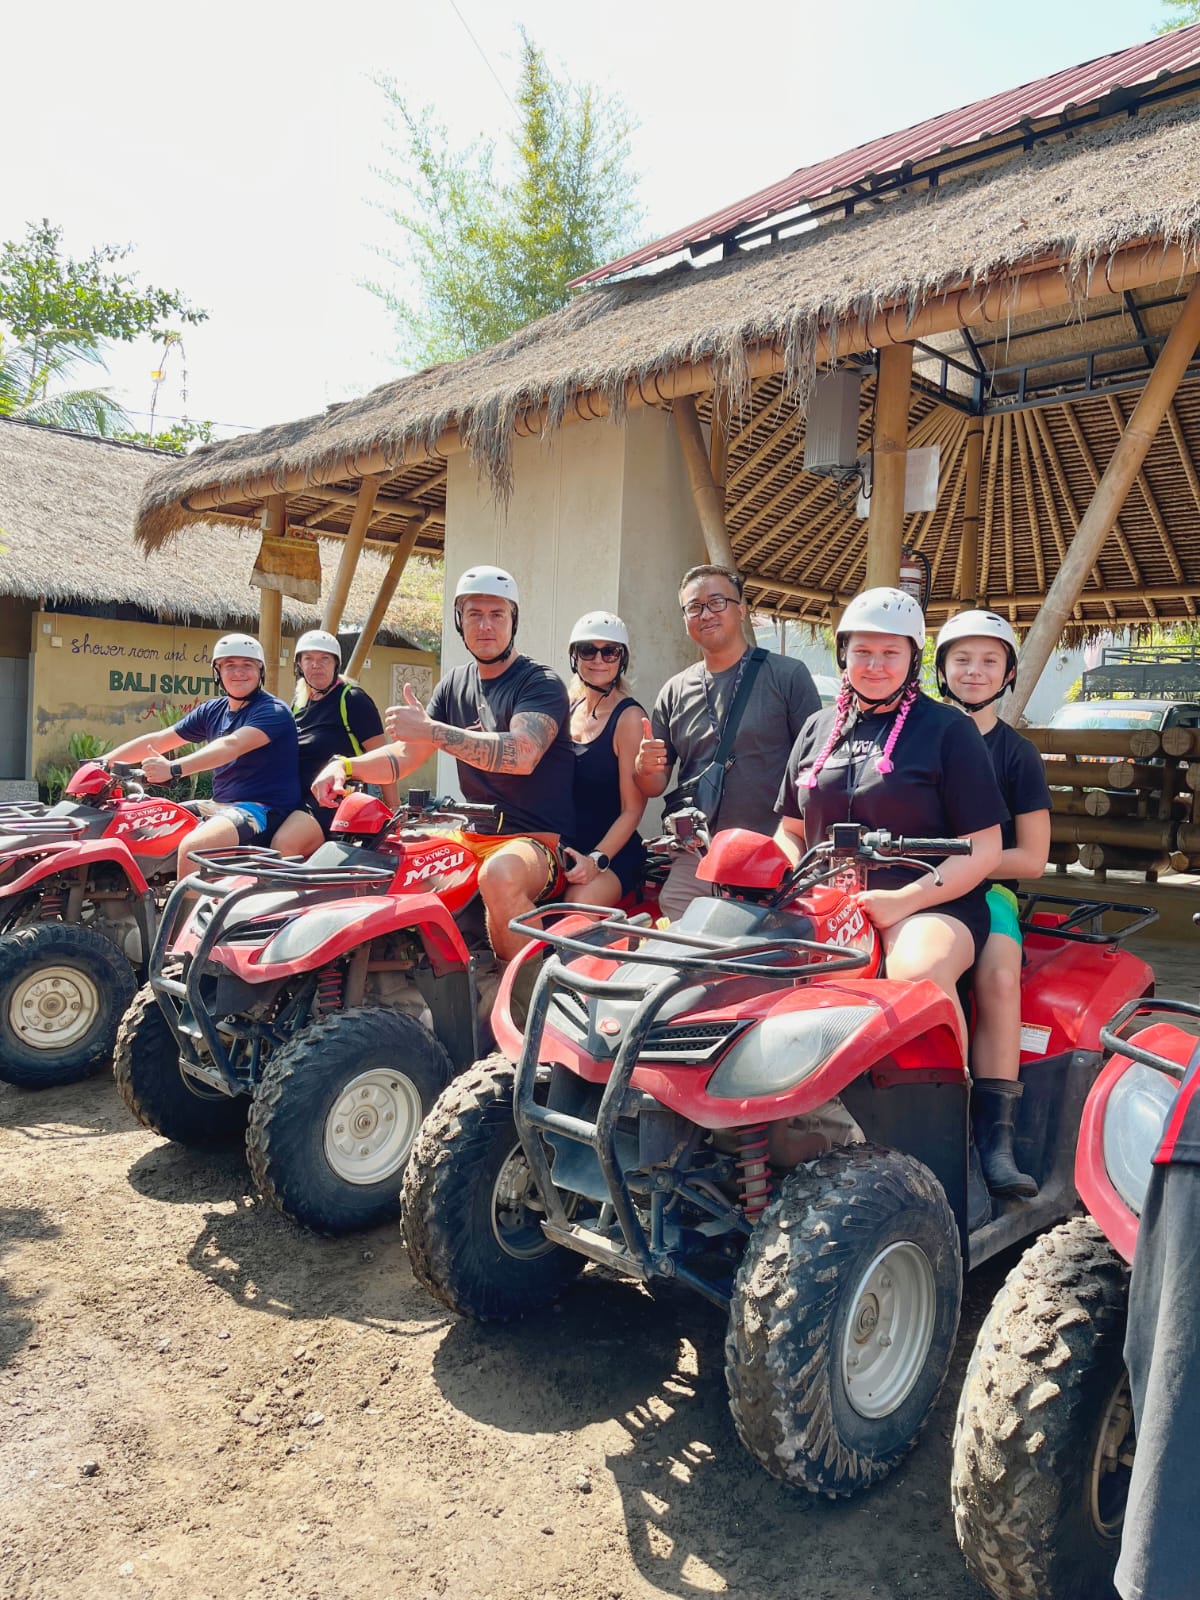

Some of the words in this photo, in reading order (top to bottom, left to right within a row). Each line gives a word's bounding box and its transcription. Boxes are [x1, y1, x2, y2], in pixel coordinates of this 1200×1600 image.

[128, 645, 160, 661] room
[164, 643, 188, 662] and
[109, 670, 156, 693] BALI
[115, 810, 178, 835] MXU
[425, 848, 450, 862] KYMCO
[403, 851, 465, 887] MXU
